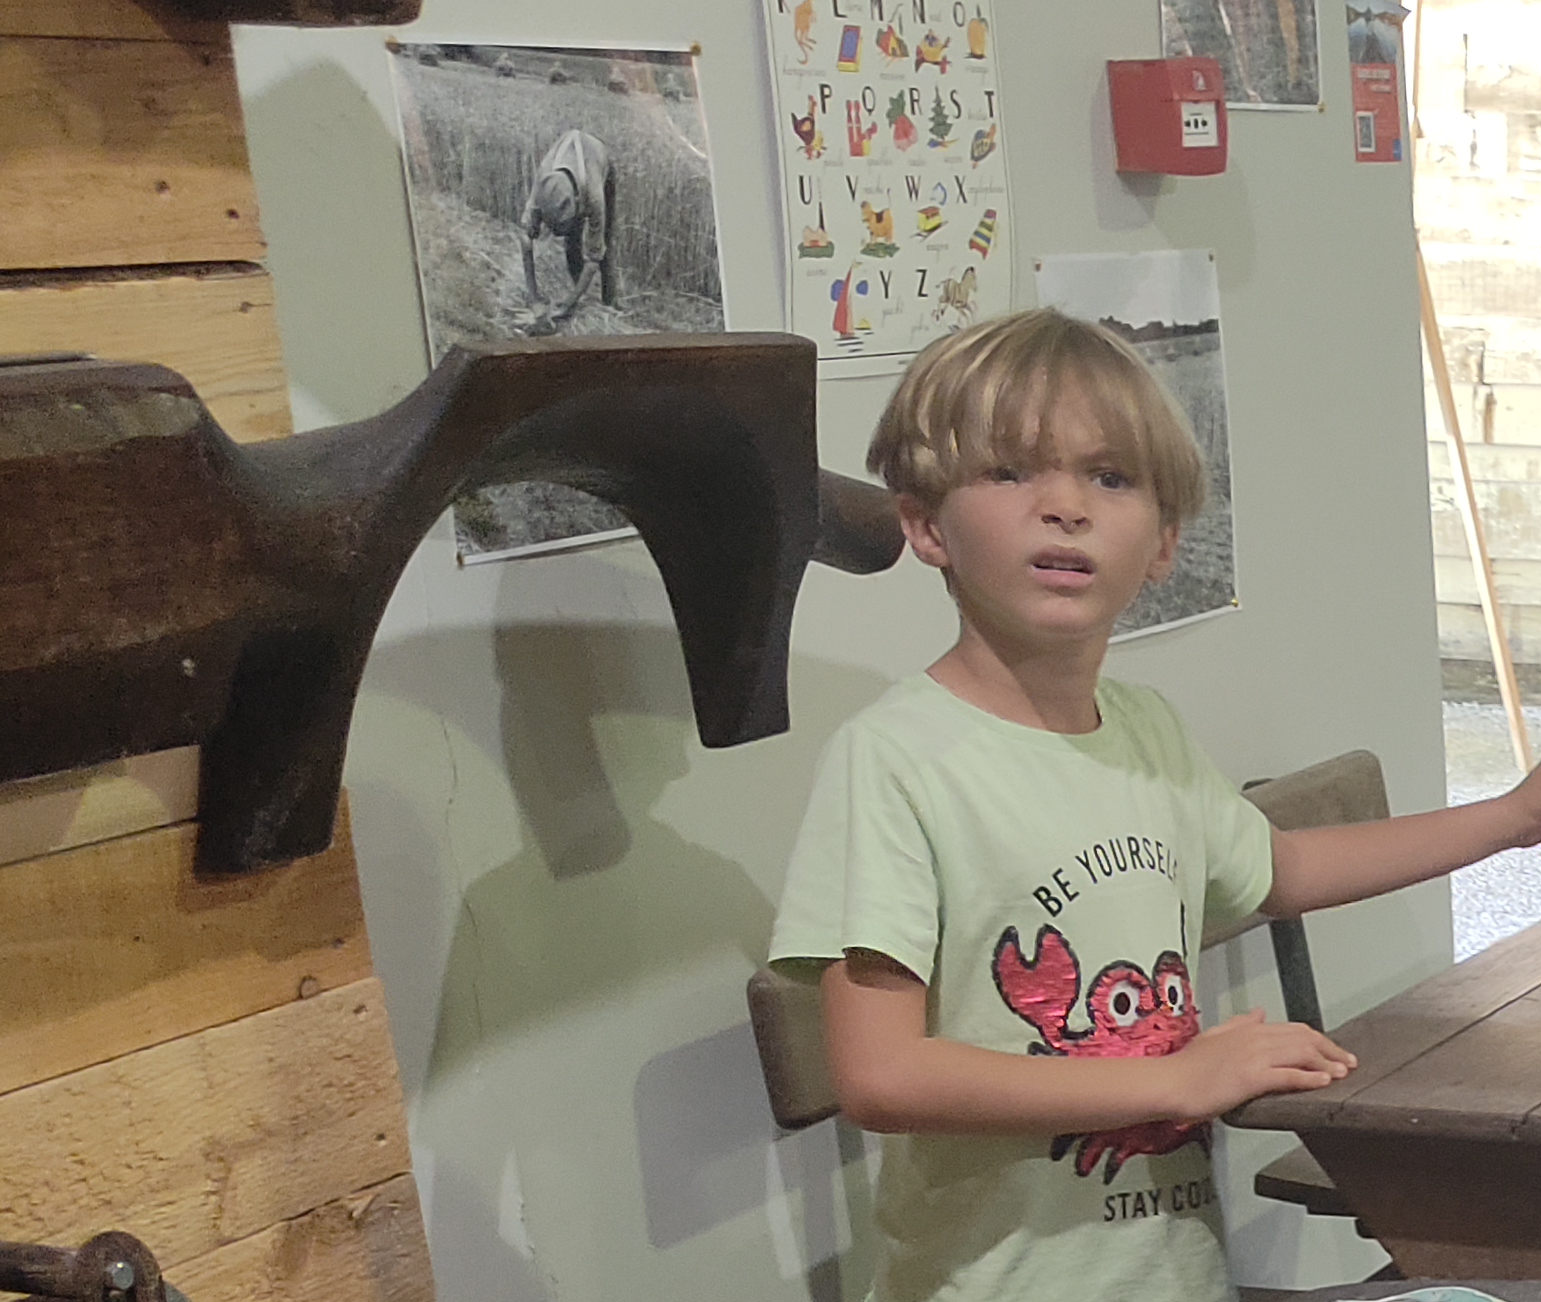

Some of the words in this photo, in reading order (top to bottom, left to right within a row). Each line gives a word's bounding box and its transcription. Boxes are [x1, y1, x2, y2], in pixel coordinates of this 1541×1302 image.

[870, 0, 884, 22] M
[912, 0, 927, 24] N
[952, 1, 966, 27] O
[818, 83, 833, 114] P
[861, 85, 876, 116] Q
[908, 87, 923, 116] R
[949, 89, 962, 119] S
[983, 90, 995, 118] T
[798, 174, 813, 205] U
[845, 174, 859, 202] V
[904, 174, 921, 202] W
[954, 174, 968, 204] X
[879, 269, 893, 300] Y
[915, 268, 929, 298] Z
[1032, 867, 1081, 918] BE
[1103, 1187, 1161, 1222] STAY
